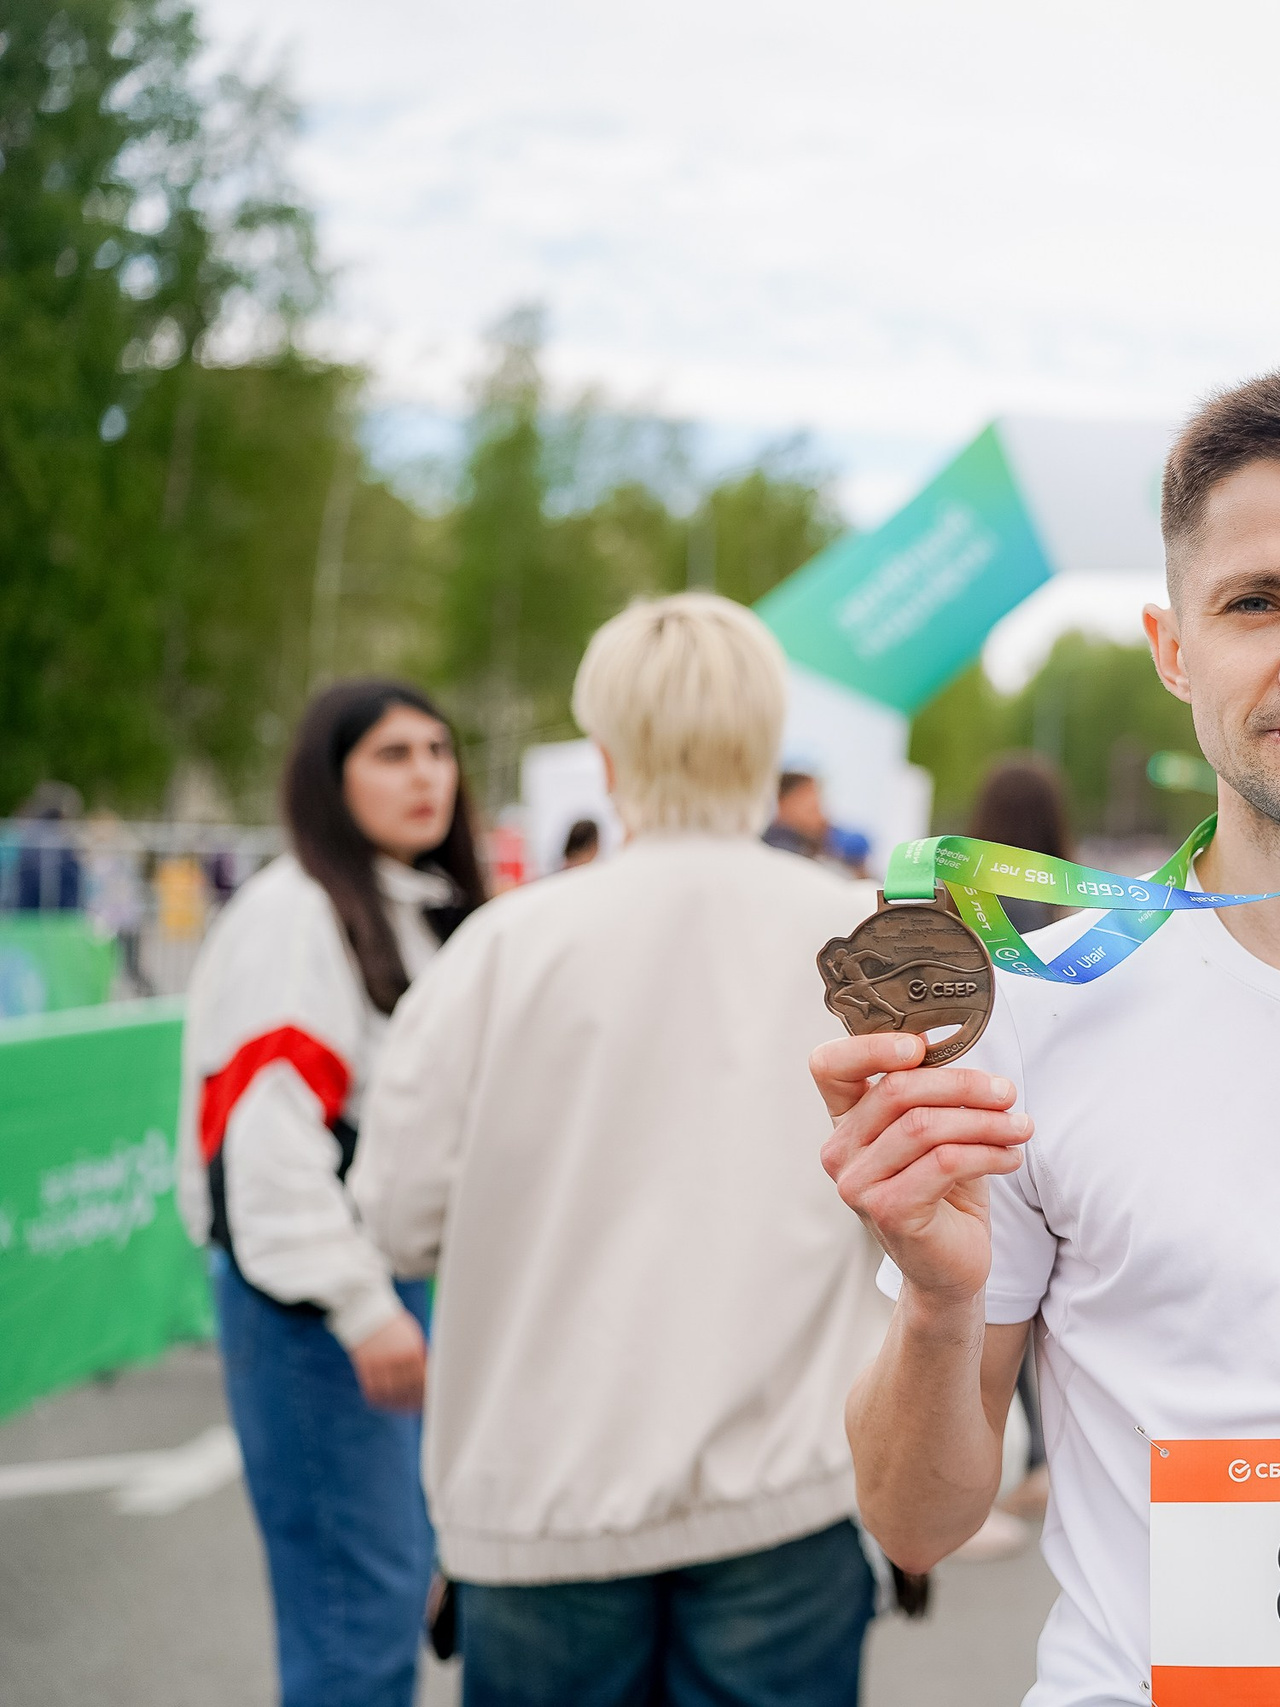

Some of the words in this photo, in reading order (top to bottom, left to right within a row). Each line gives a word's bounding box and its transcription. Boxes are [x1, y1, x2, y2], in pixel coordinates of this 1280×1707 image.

[990, 862, 1020, 876] лет
[1024, 868, 1057, 886] 185
[1076, 881, 1125, 897] СБЕР
[970, 900, 992, 931] лет
[1076, 945, 1107, 969] Utair
[931, 982, 977, 997] СБЕР
[925, 1041, 965, 1062] арафон
